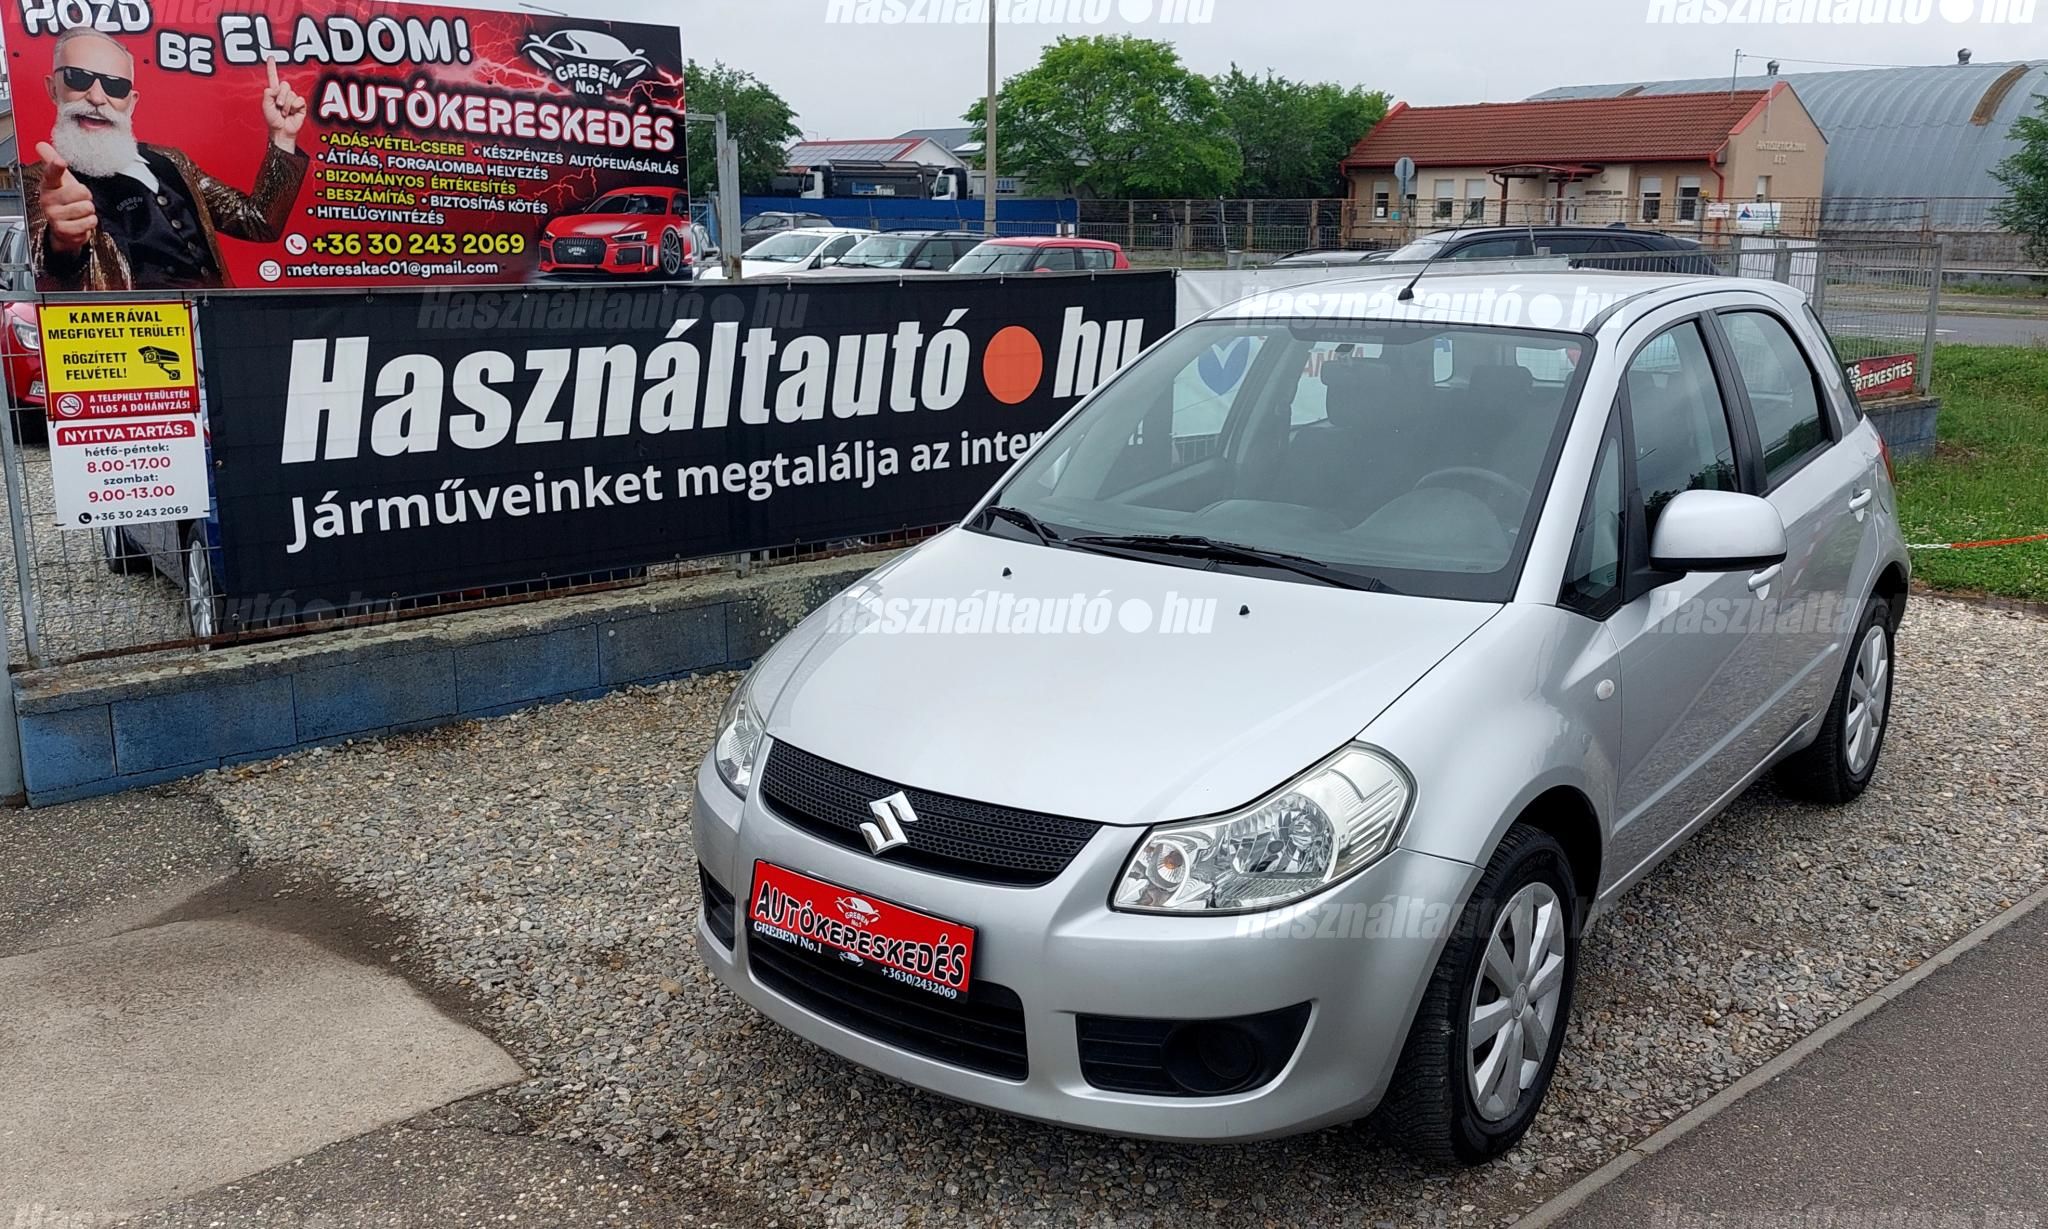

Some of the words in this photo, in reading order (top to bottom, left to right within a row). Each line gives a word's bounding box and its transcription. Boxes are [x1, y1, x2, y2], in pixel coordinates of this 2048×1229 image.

[21, 0, 152, 34] HOZD
[220, 15, 471, 63] ELADOM!
[159, 31, 213, 74] BE
[555, 62, 622, 89] GREBEN
[575, 80, 604, 95] No.1
[319, 79, 675, 151] AUTÓKERESKEDÉS
[329, 132, 465, 156] ADÁS-VÉTEL-CSERE
[326, 148, 383, 169] ÁTÍRÁS,
[387, 156, 484, 175] FORGALOMBA
[487, 165, 549, 180] HELYEZÉS
[482, 144, 564, 165] KÉSZPÉNZES
[568, 154, 680, 175] AUTÓFELVÁSÁRLÁS
[325, 170, 425, 187] BIZOMÁNYOS
[430, 177, 516, 195] ÉRTÉKESÍTÉS
[326, 188, 416, 205] BESZÁMÍTÁS
[430, 195, 505, 211] BIZTOSÍTÁS
[508, 199, 548, 215] KÖTÉS
[317, 205, 445, 225] HITELÜGYINTÉZÉS
[312, 233, 361, 254] +36
[367, 233, 402, 254] 30
[408, 233, 457, 254] 243
[463, 233, 525, 254] 2069
[69, 308, 163, 324] KAMERÁVAL
[48, 327, 125, 340] MEGFIGYELT
[129, 324, 186, 339] TERÜLET!
[63, 350, 127, 365] RÖGZÍTETT
[66, 366, 128, 381] FELVÉTEL!
[89, 395, 96, 403] A
[97, 391, 143, 402] TELEPHELY
[144, 389, 190, 401] TERÜLETÉN
[281, 308, 970, 464] Használtautó
[90, 404, 118, 414] TILOS
[121, 404, 128, 413] A
[130, 400, 191, 412] DOHÁNYZÁS!
[64, 428, 125, 443] NYITVA
[126, 422, 189, 438] TARTÁS:
[84, 442, 170, 458] hétfő-péntek:
[87, 456, 171, 474] 8.00-17.00
[103, 473, 159, 486] szombat:
[88, 485, 175, 503] 9.00-13.00
[286, 465, 664, 554] Járműveinket
[676, 439, 900, 502] megtalálja
[910, 441, 951, 473] az
[94, 512, 115, 521] +36
[118, 510, 133, 520] 30
[136, 507, 157, 518] 243
[161, 505, 189, 516] 2069
[753, 920, 798, 945] GREBEN
[799, 936, 822, 954] No.1
[755, 880, 967, 988] AUTÓKERESKEDÉS
[881, 966, 958, 1000] +3630/2432069
